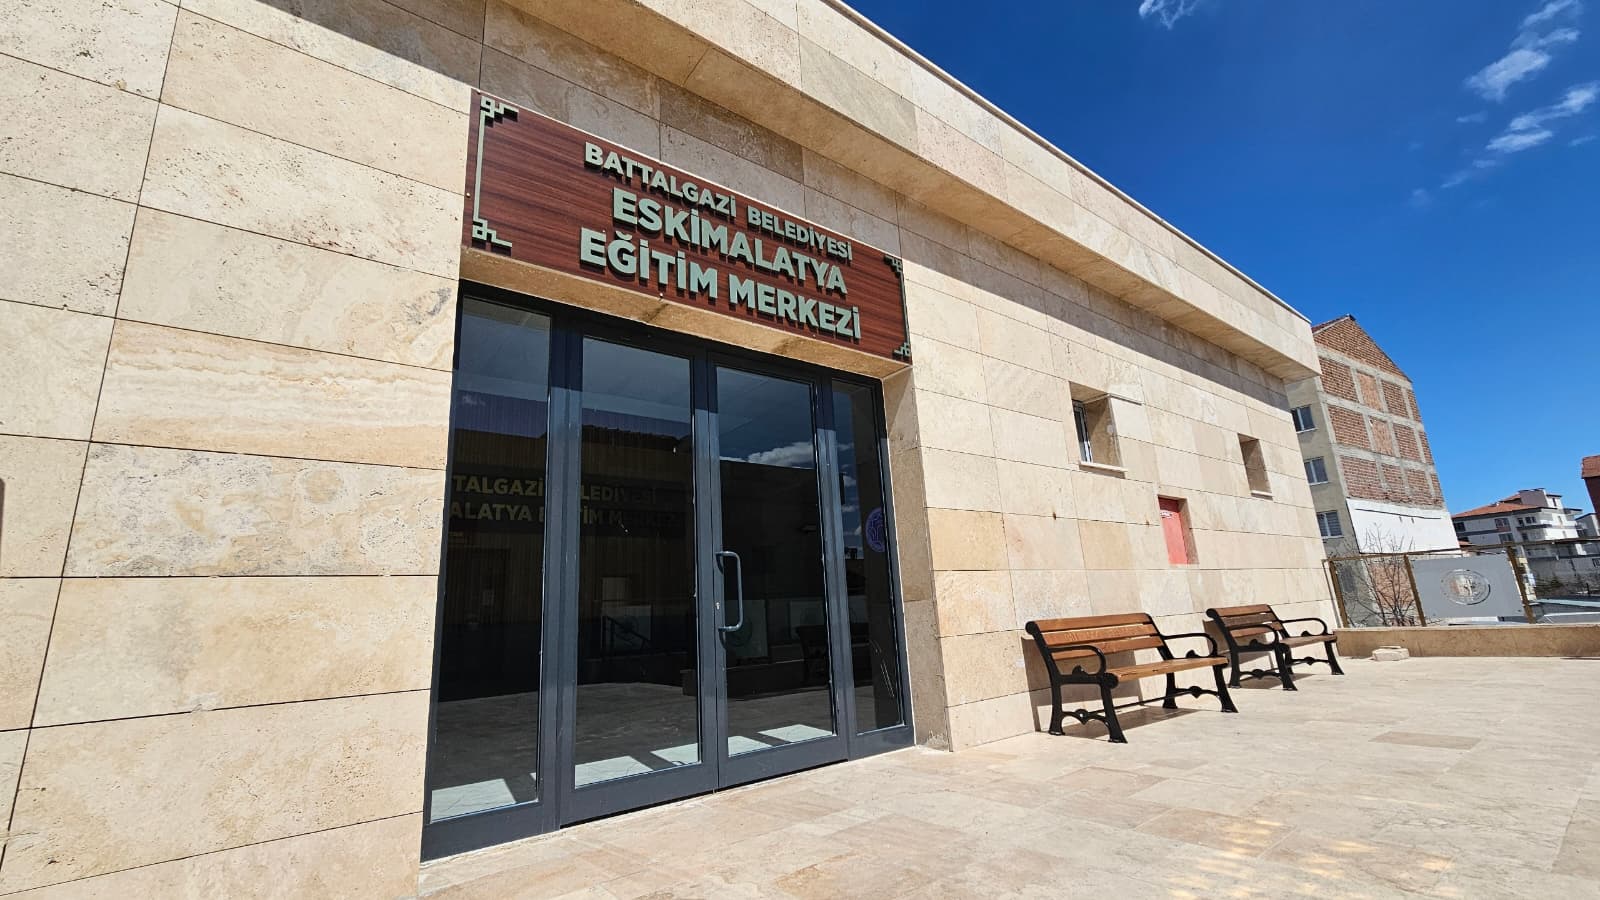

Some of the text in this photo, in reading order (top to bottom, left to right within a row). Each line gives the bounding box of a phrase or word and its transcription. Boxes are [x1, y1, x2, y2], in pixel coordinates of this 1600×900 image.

[585, 141, 853, 261] BATTALGAZİ BELEDİYESİ
[613, 186, 848, 295] ESKİMALATYA
[580, 226, 862, 340] EĞİTİM MERKEZİ
[449, 501, 533, 522] ALATYA
[452, 474, 544, 497] TALGAZİ
